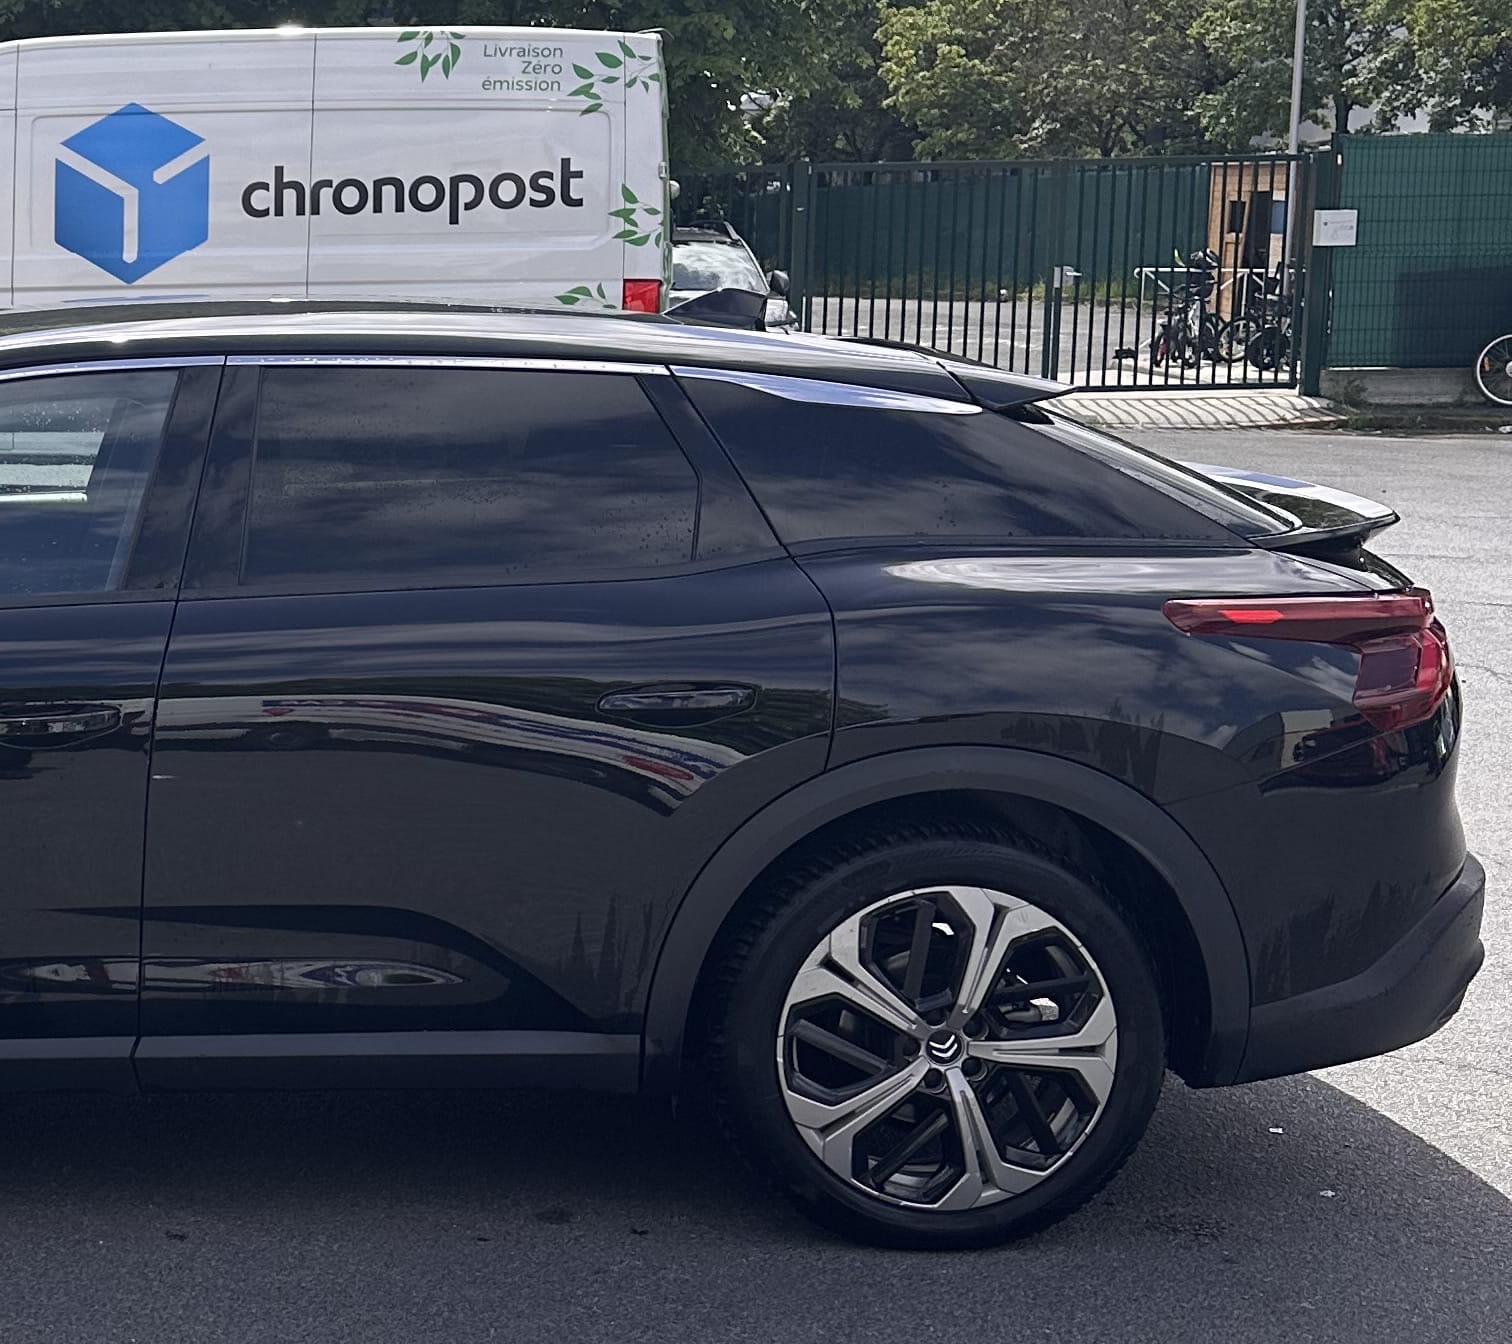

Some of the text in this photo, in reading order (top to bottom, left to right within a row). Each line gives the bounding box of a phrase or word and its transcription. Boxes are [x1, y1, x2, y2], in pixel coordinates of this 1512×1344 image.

[483, 43, 564, 58] Livraison
[521, 59, 563, 75] Zéro
[481, 75, 561, 91] émission
[241, 157, 584, 225] chronopost
